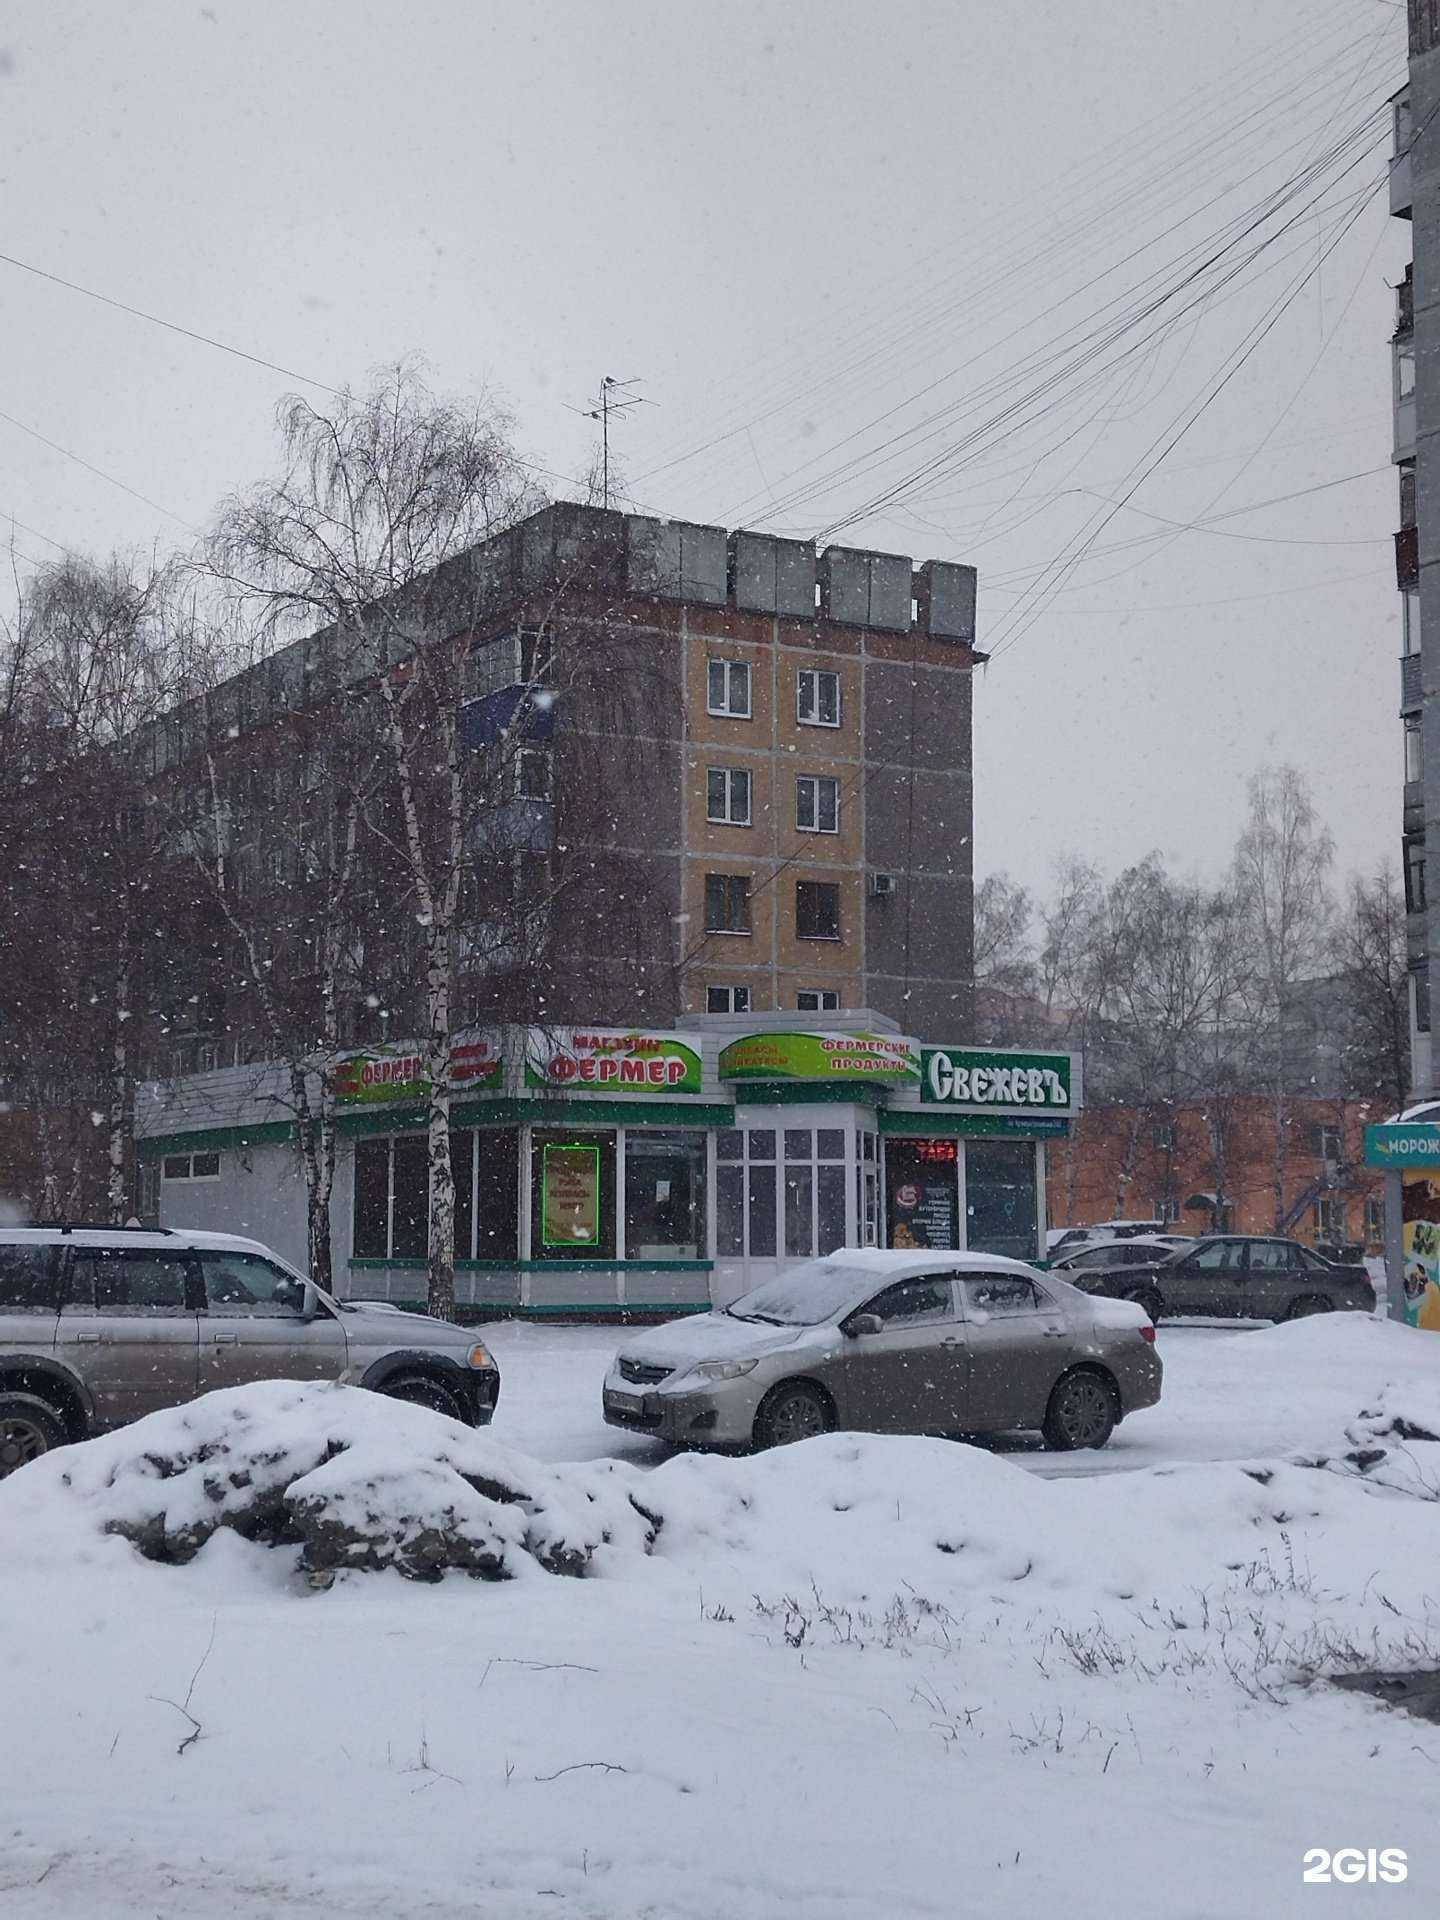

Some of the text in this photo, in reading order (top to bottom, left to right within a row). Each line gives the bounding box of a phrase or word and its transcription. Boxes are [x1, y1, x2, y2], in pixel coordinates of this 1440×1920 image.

[573, 1035, 662, 1052] МАГАЗИН
[820, 1039, 912, 1055] ФЕРМЕРСКИЕ
[548, 1054, 688, 1085] ФЕРМЕР
[830, 1057, 907, 1071] ПРОДУКТЫ
